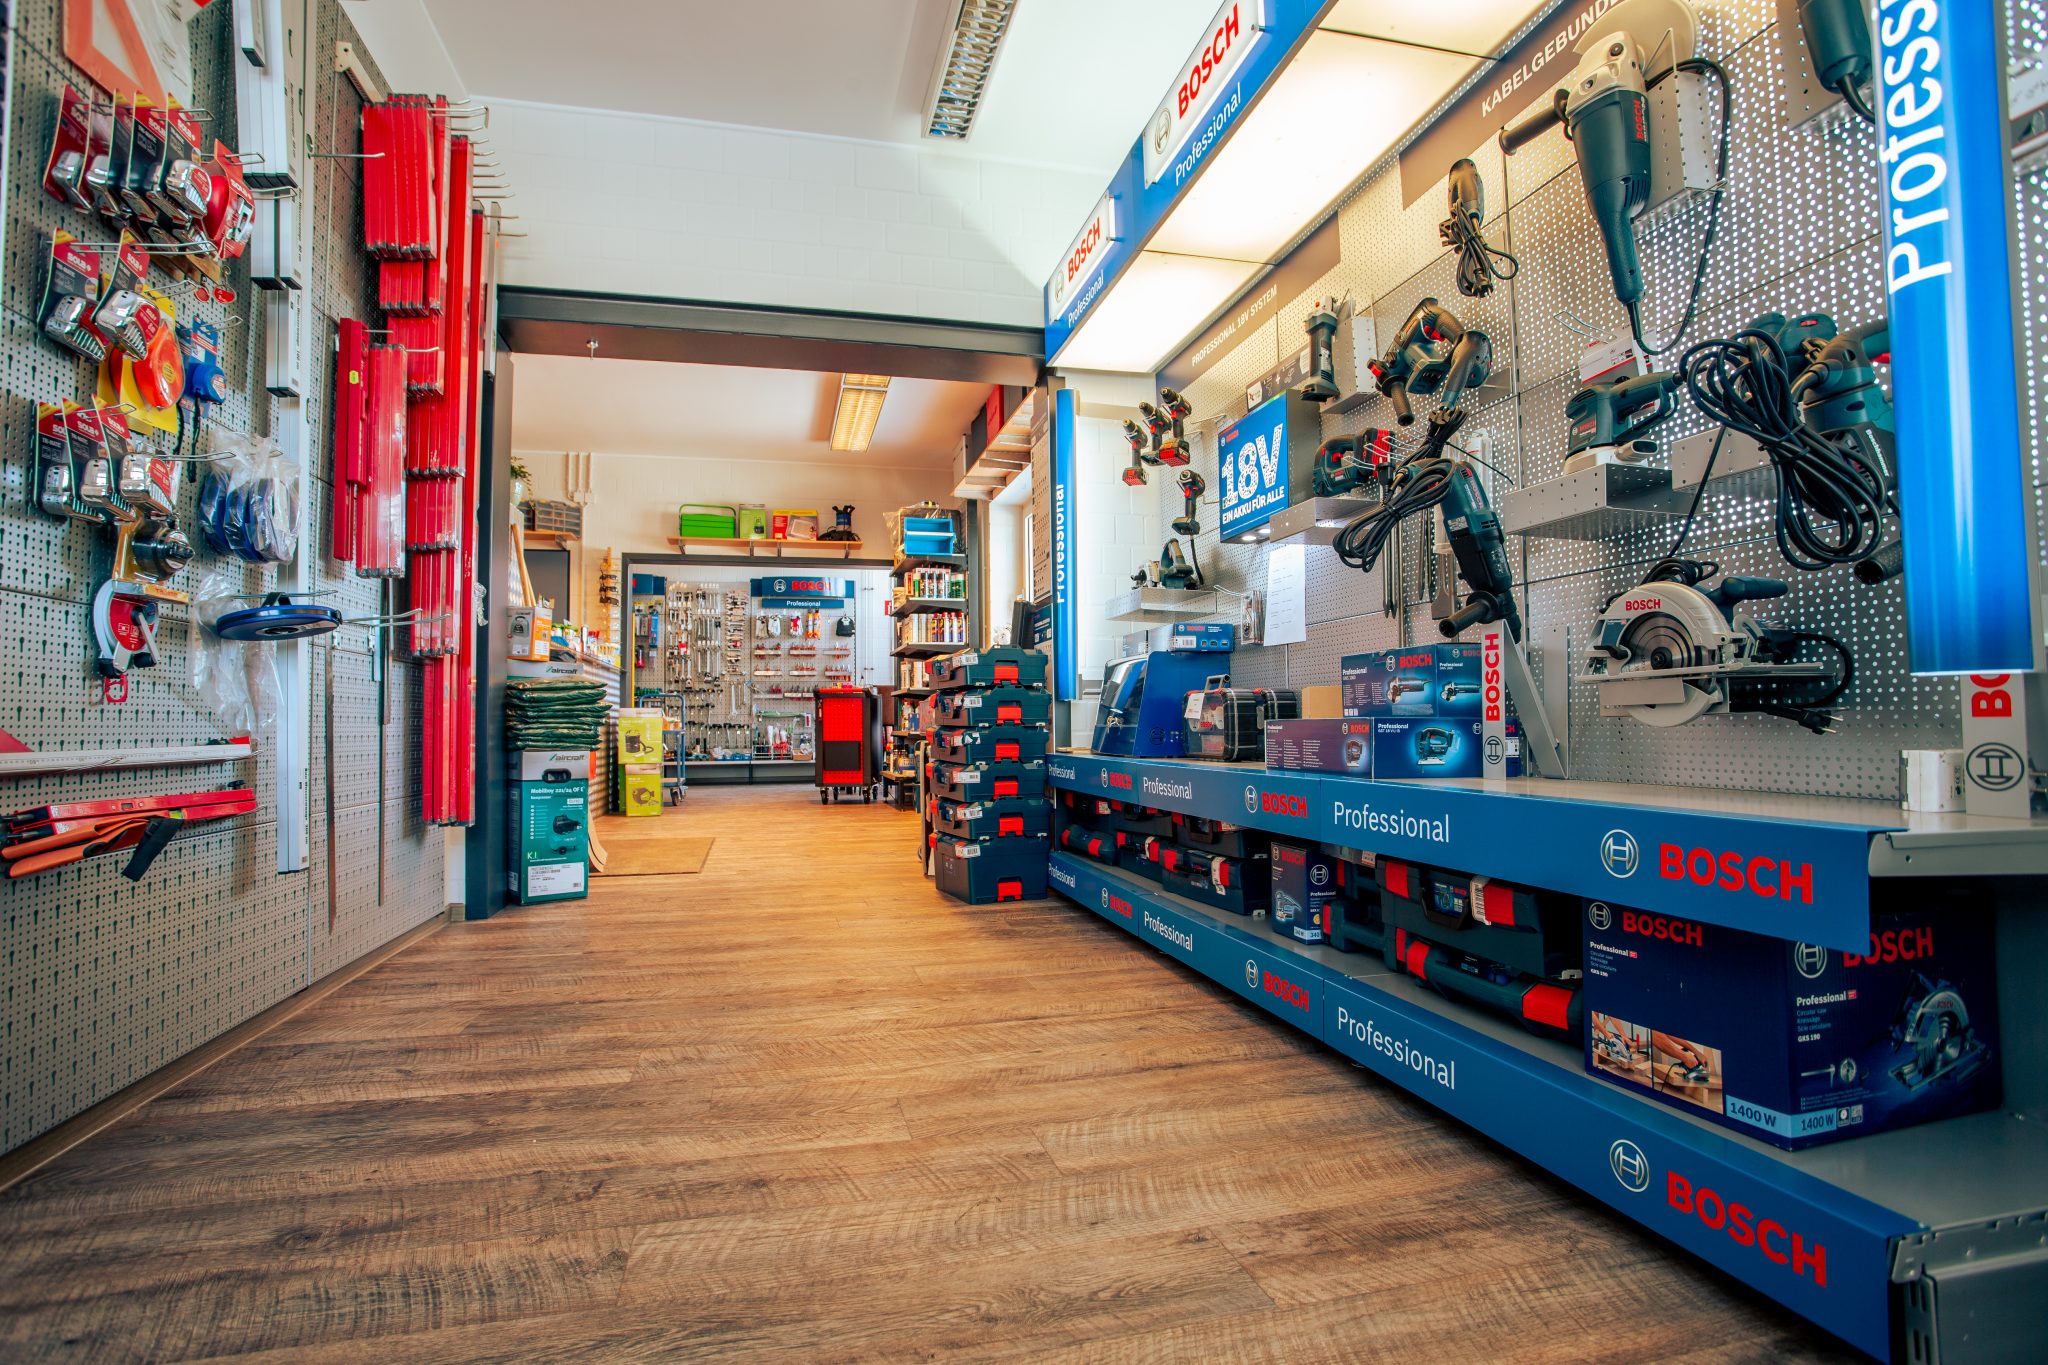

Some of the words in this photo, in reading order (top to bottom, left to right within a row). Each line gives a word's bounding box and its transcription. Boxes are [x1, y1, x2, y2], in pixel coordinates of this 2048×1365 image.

[1177, 2, 1239, 120] BOSCH
[1175, 82, 1241, 186] Professional
[1633, 100, 1644, 140] BOSCH
[1879, 0, 1953, 295] Profess
[1068, 216, 1100, 282] BOSCH
[1068, 269, 1104, 329] Professional
[1192, 322, 1236, 367] PROFESSIONAL
[1238, 308, 1250, 329] 18V
[1250, 284, 1277, 316] SYSTEM
[1222, 422, 1284, 510] 18V
[1222, 508, 1233, 525] EIN
[1233, 500, 1252, 519] AKKU
[1252, 494, 1266, 514] FÜR
[1266, 486, 1284, 504] ALLE
[1056, 484, 1065, 603] Professional
[792, 580, 831, 591] BOSCH
[1626, 598, 1661, 611] BOSCH
[1342, 666, 1368, 676] Professional
[1399, 653, 1432, 669] BOSCH
[1485, 633, 1500, 721] BOSCH
[1350, 724, 1370, 734] BOSCH
[1048, 764, 1076, 780] Professional
[1110, 772, 1132, 790] BOSCH
[1143, 776, 1192, 800] Professional
[1262, 792, 1308, 818] BOSCH
[1334, 801, 1450, 843] Professional
[1048, 862, 1076, 888] Professional
[1282, 851, 1304, 865] BOSCH
[1660, 842, 1812, 904] BOSCH
[1110, 894, 1132, 919] BOSCH
[1144, 911, 1193, 952] Professional
[1622, 911, 1702, 947] BOSCH
[1590, 941, 1628, 956] Professional
[1263, 970, 1309, 1012] BOSCH
[1796, 990, 1846, 1006] Professional
[1338, 1006, 1455, 1090] Professional
[1730, 1102, 1762, 1122] 1400
[1764, 1112, 1776, 1127] W
[1801, 1116, 1824, 1130] 1400
[1826, 1114, 1834, 1126] W
[1667, 1170, 1827, 1289] BOSCH
